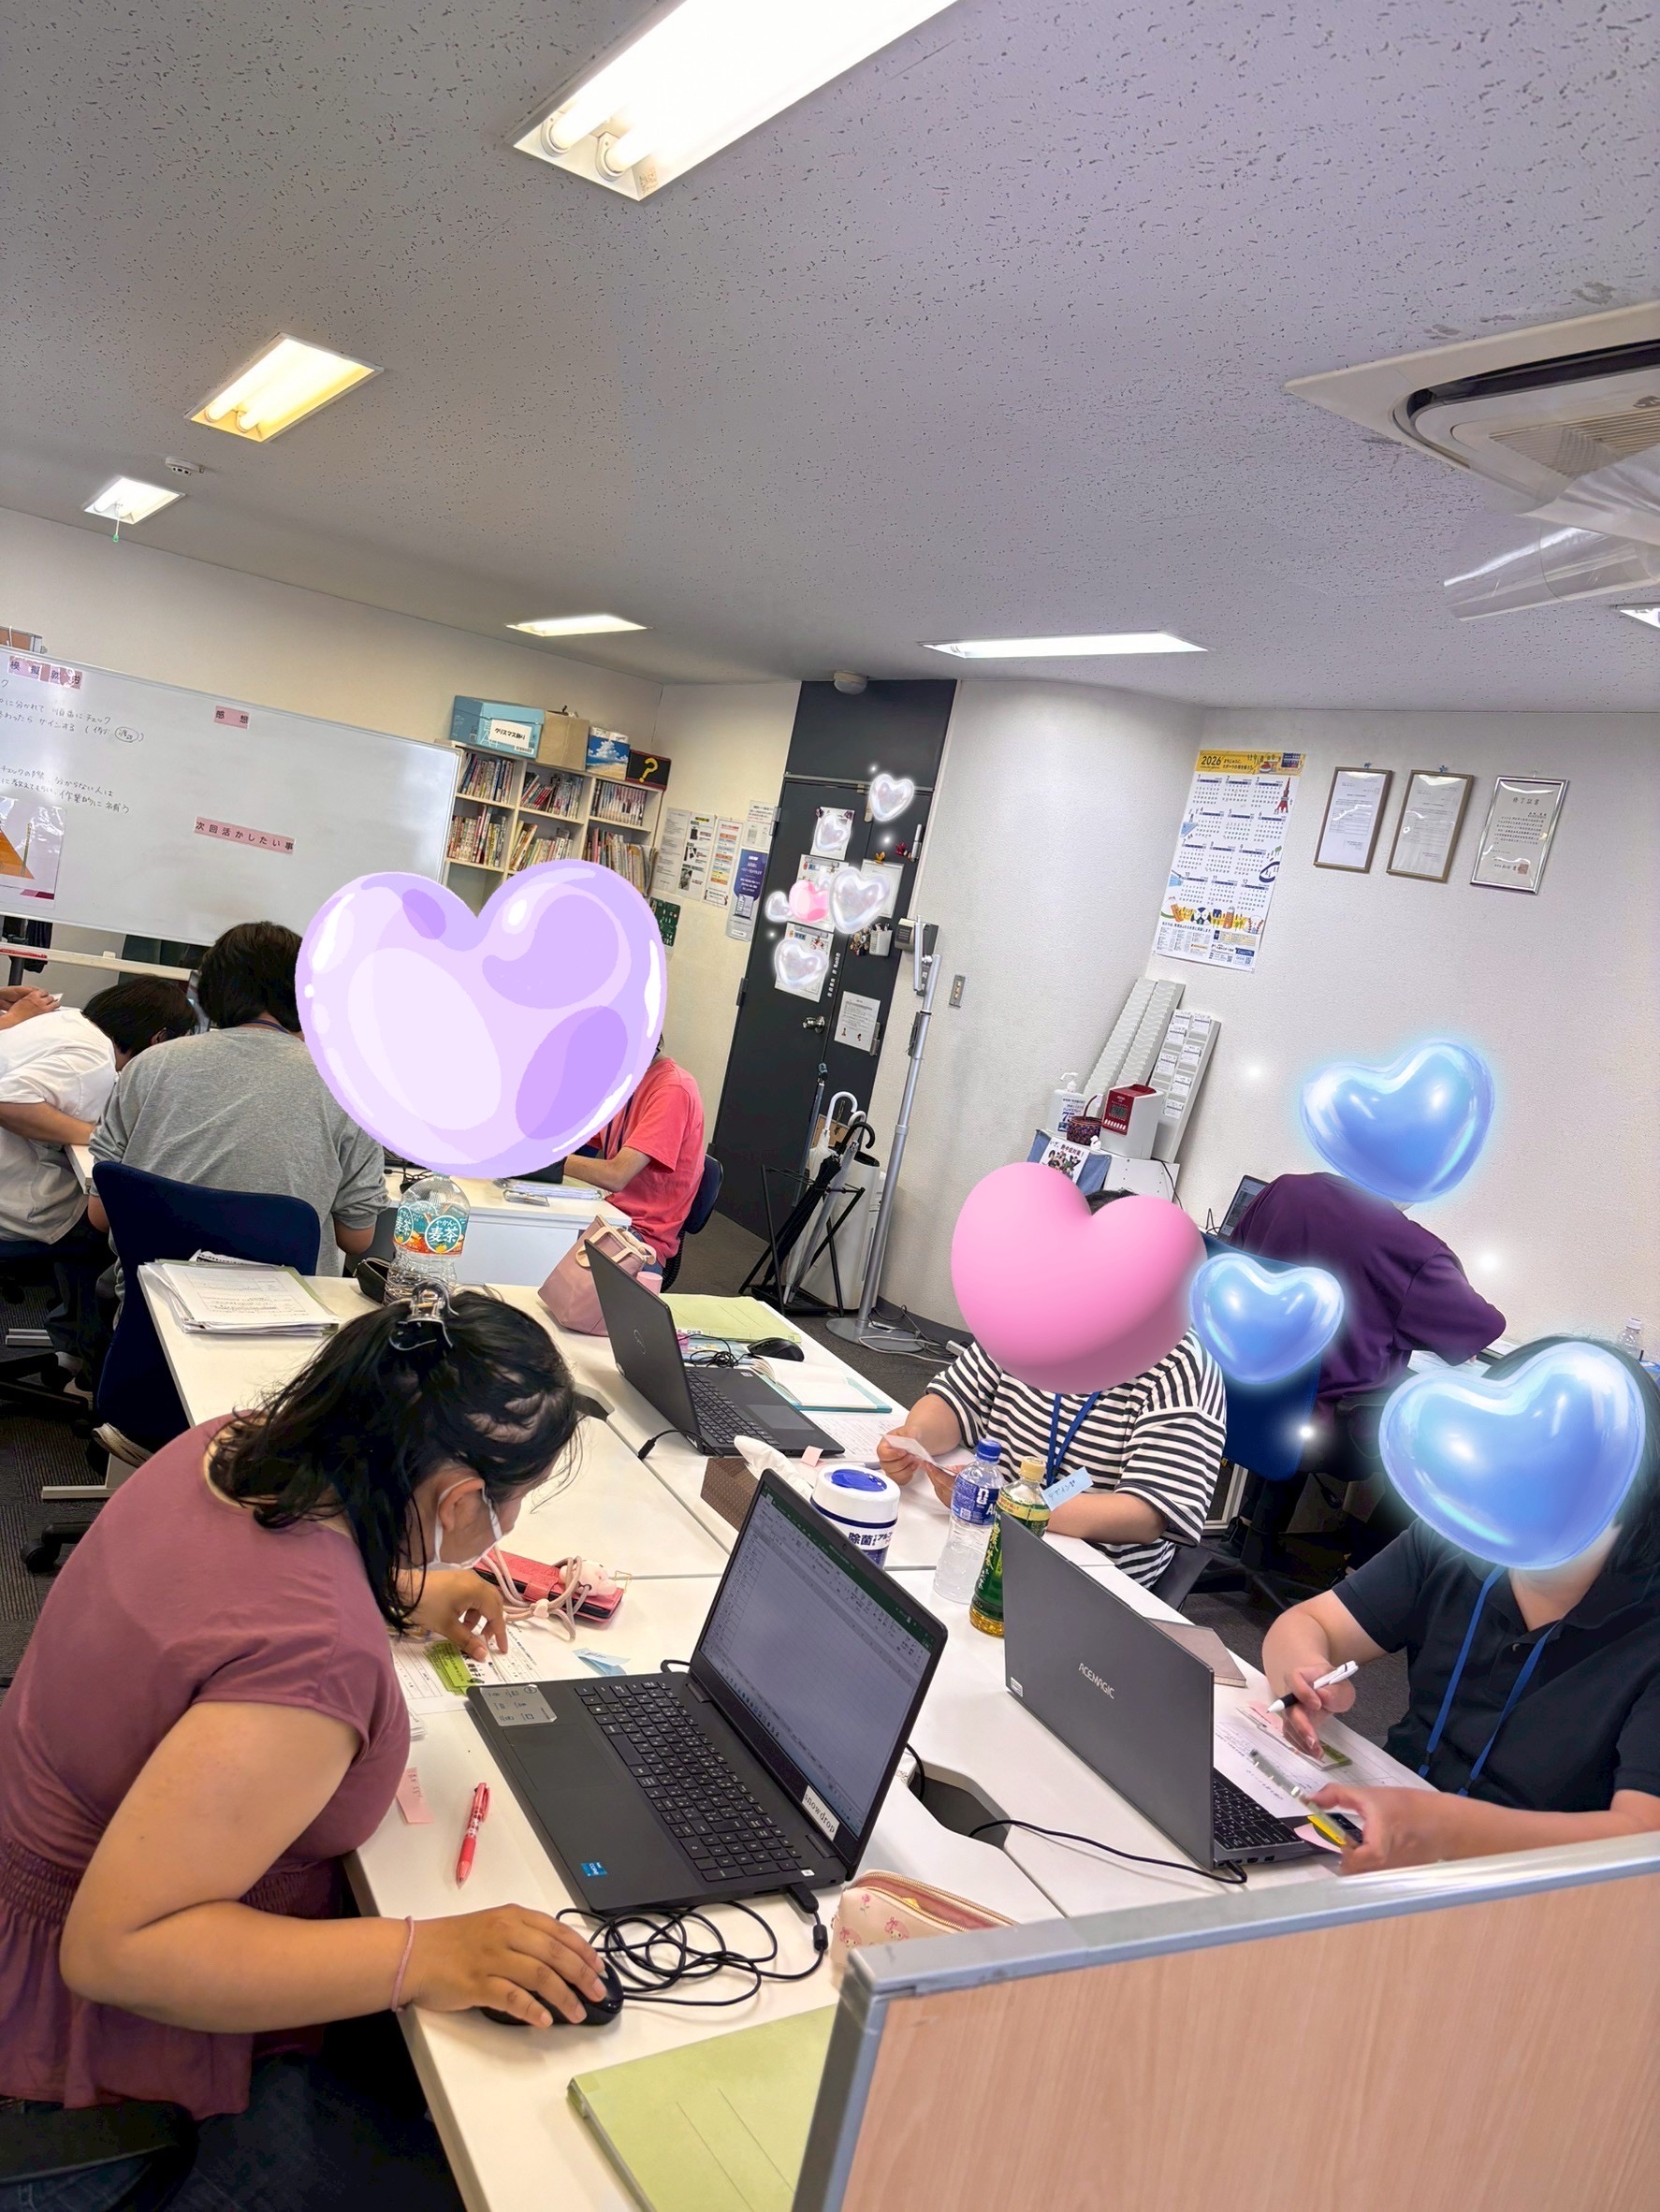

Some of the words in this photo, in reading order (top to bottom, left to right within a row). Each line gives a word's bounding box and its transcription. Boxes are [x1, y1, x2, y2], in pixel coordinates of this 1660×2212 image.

[216, 710, 249, 724] 感想
[1201, 755, 1222, 766] 2026
[196, 821, 294, 851] 次回活かしたい事
[429, 1227, 459, 1243] 麦茶
[849, 1532, 873, 1546] 除菌
[1079, 1663, 1114, 1699] ACEMAGIC
[804, 1793, 835, 1833] snowdrop
